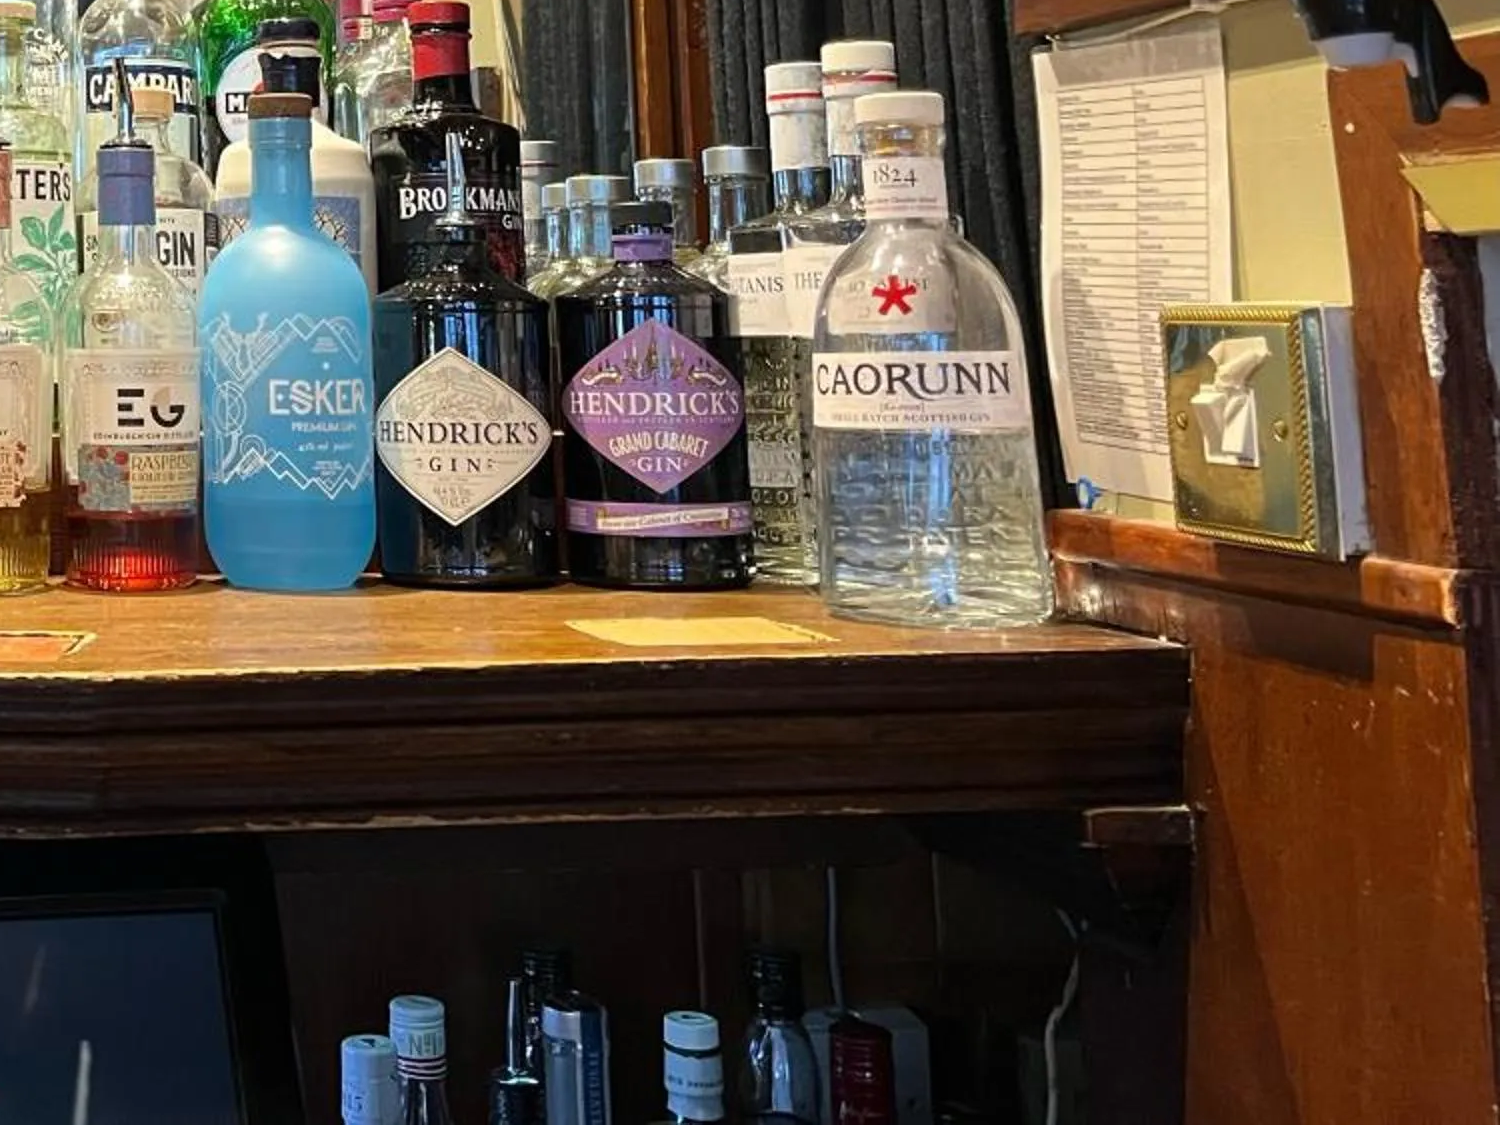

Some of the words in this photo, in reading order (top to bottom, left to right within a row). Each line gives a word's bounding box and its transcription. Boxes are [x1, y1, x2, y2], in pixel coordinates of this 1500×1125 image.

[15, 163, 72, 202] TER'S
[873, 164, 919, 188] 1824
[399, 186, 521, 219] BROKMANS
[156, 231, 195, 266] GIN
[817, 362, 1011, 400] CAORUNN
[269, 378, 367, 415] ESKER
[570, 390, 739, 416] HENDRICK'S
[380, 420, 539, 445] HENDRICK'S
[609, 432, 651, 458] GRAND
[654, 430, 708, 457] CABARET
[429, 457, 481, 473] GIN
[637, 456, 682, 473] GIN
